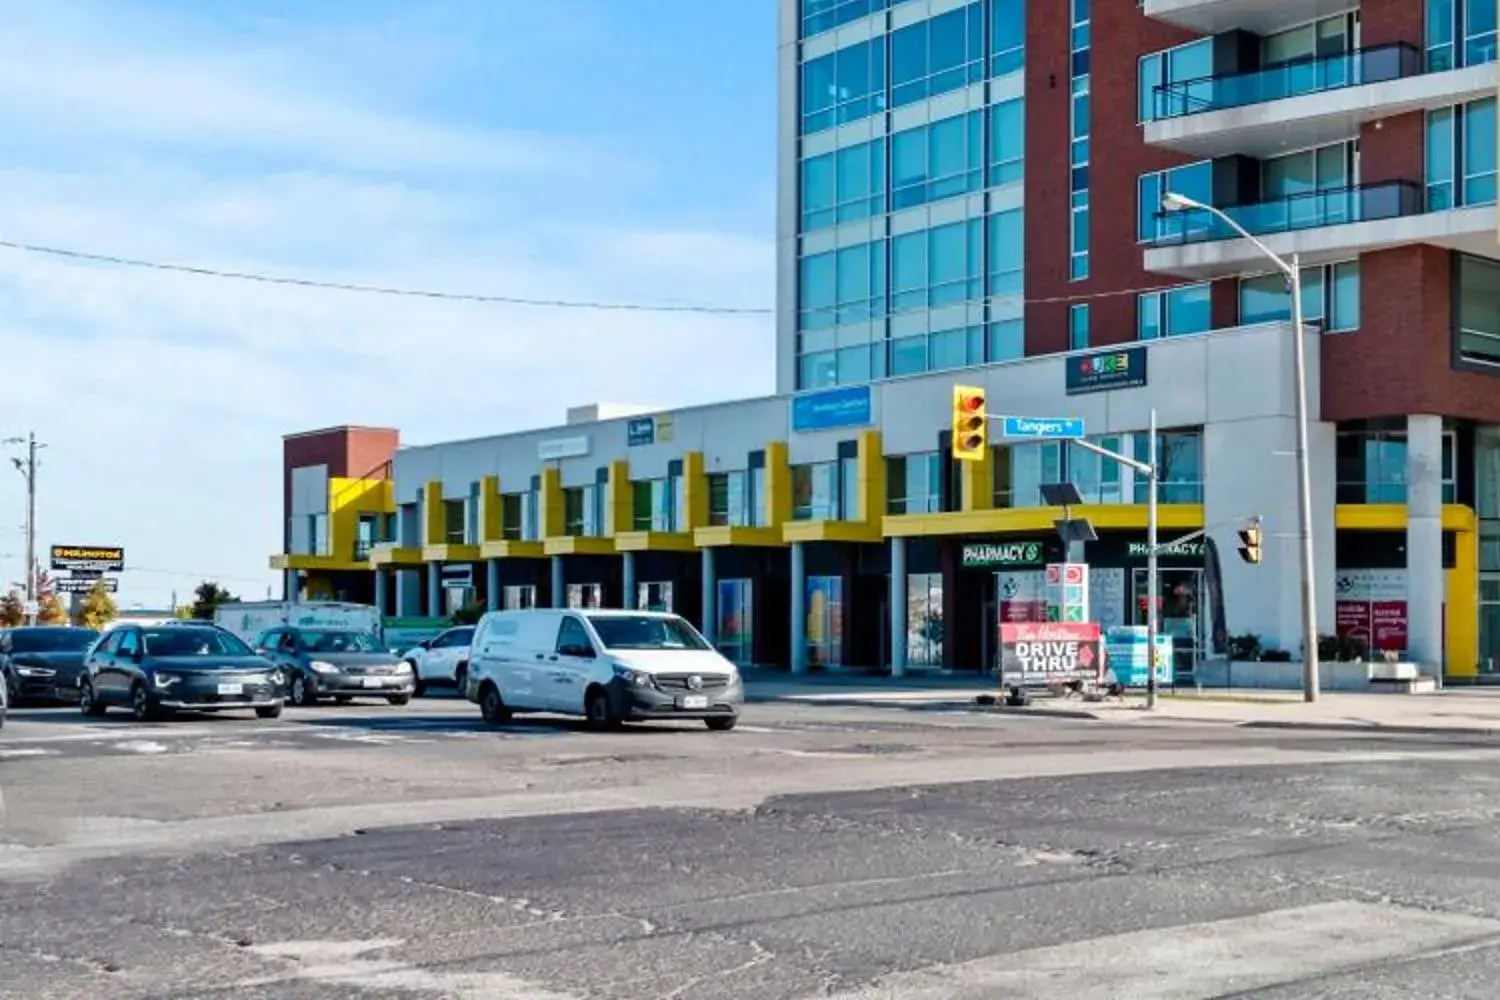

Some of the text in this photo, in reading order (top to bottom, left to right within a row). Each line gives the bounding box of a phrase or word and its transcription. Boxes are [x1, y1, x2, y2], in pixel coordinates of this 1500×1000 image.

[1016, 419, 1063, 436] Tangiers
[963, 545, 1025, 563] PHARMACY
[1015, 641, 1079, 656] DRIVE
[1018, 655, 1076, 671] THRU
